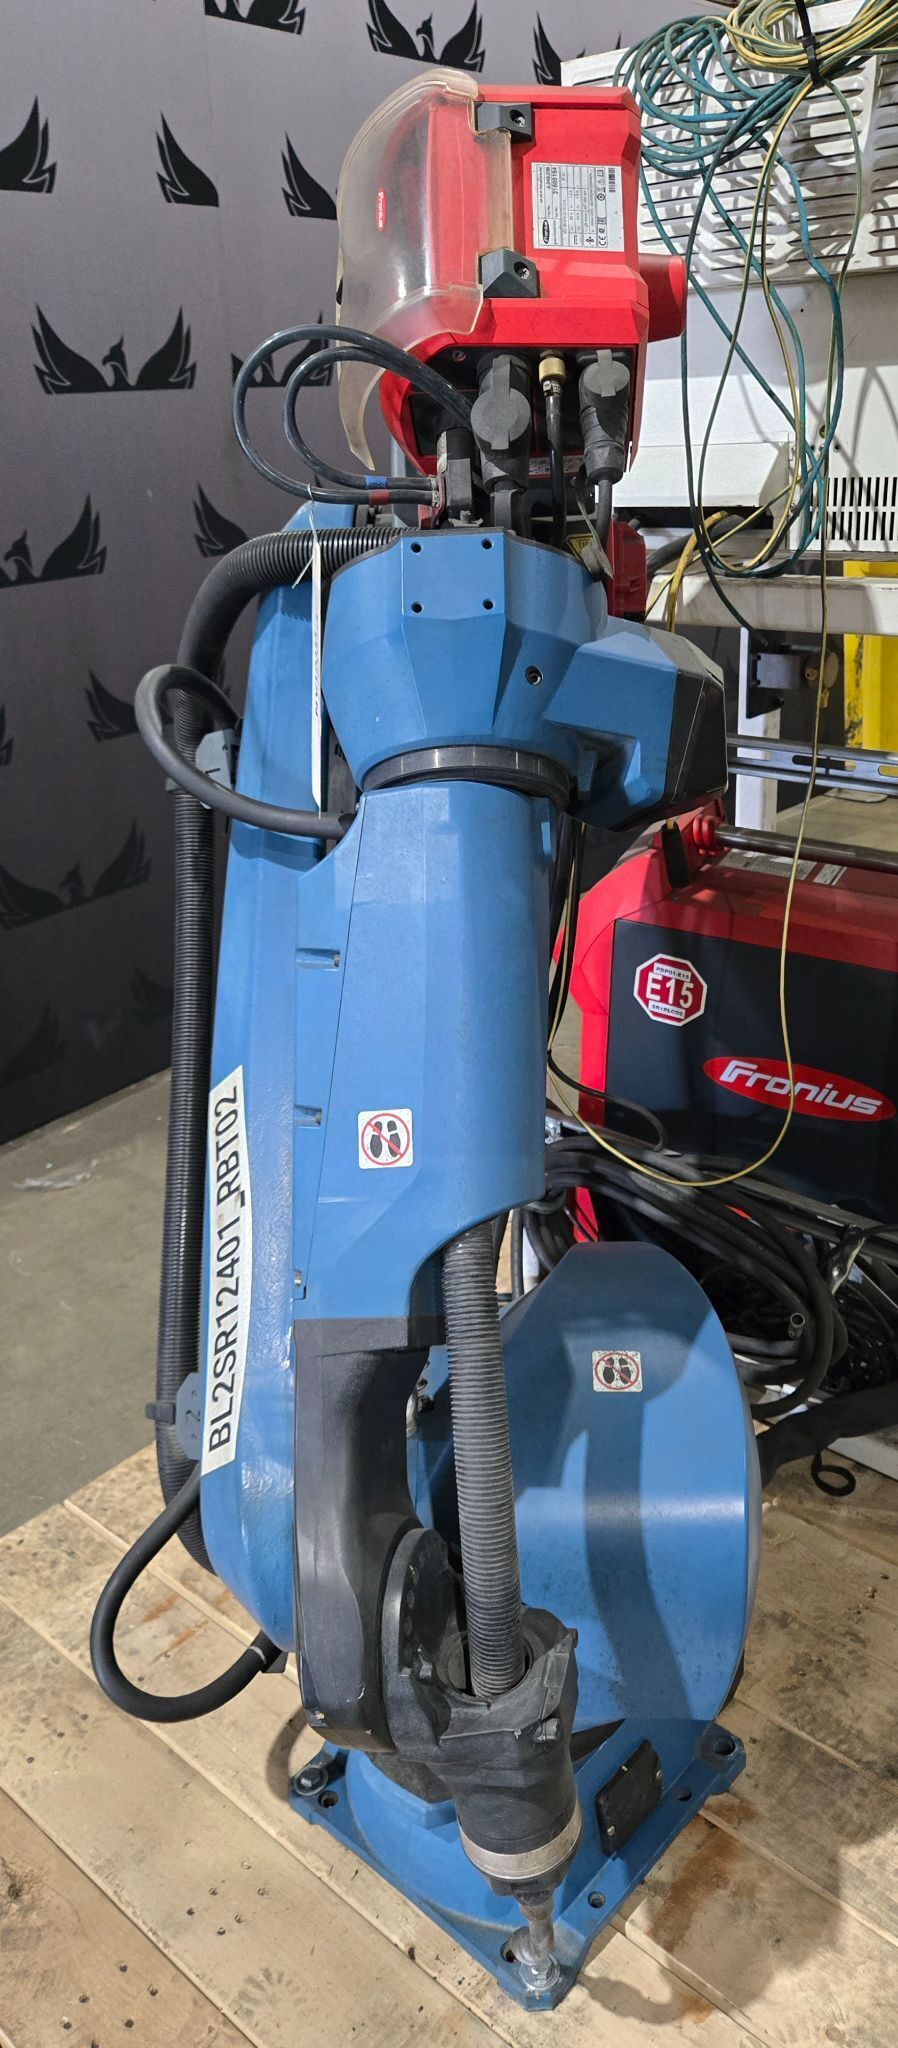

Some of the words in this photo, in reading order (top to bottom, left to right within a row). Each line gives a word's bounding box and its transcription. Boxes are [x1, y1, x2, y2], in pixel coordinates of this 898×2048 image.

[646, 971, 695, 1009] E15
[720, 1059, 883, 1116] Fronius
[209, 1085, 246, 1453] BL2SR12401_RBT02
